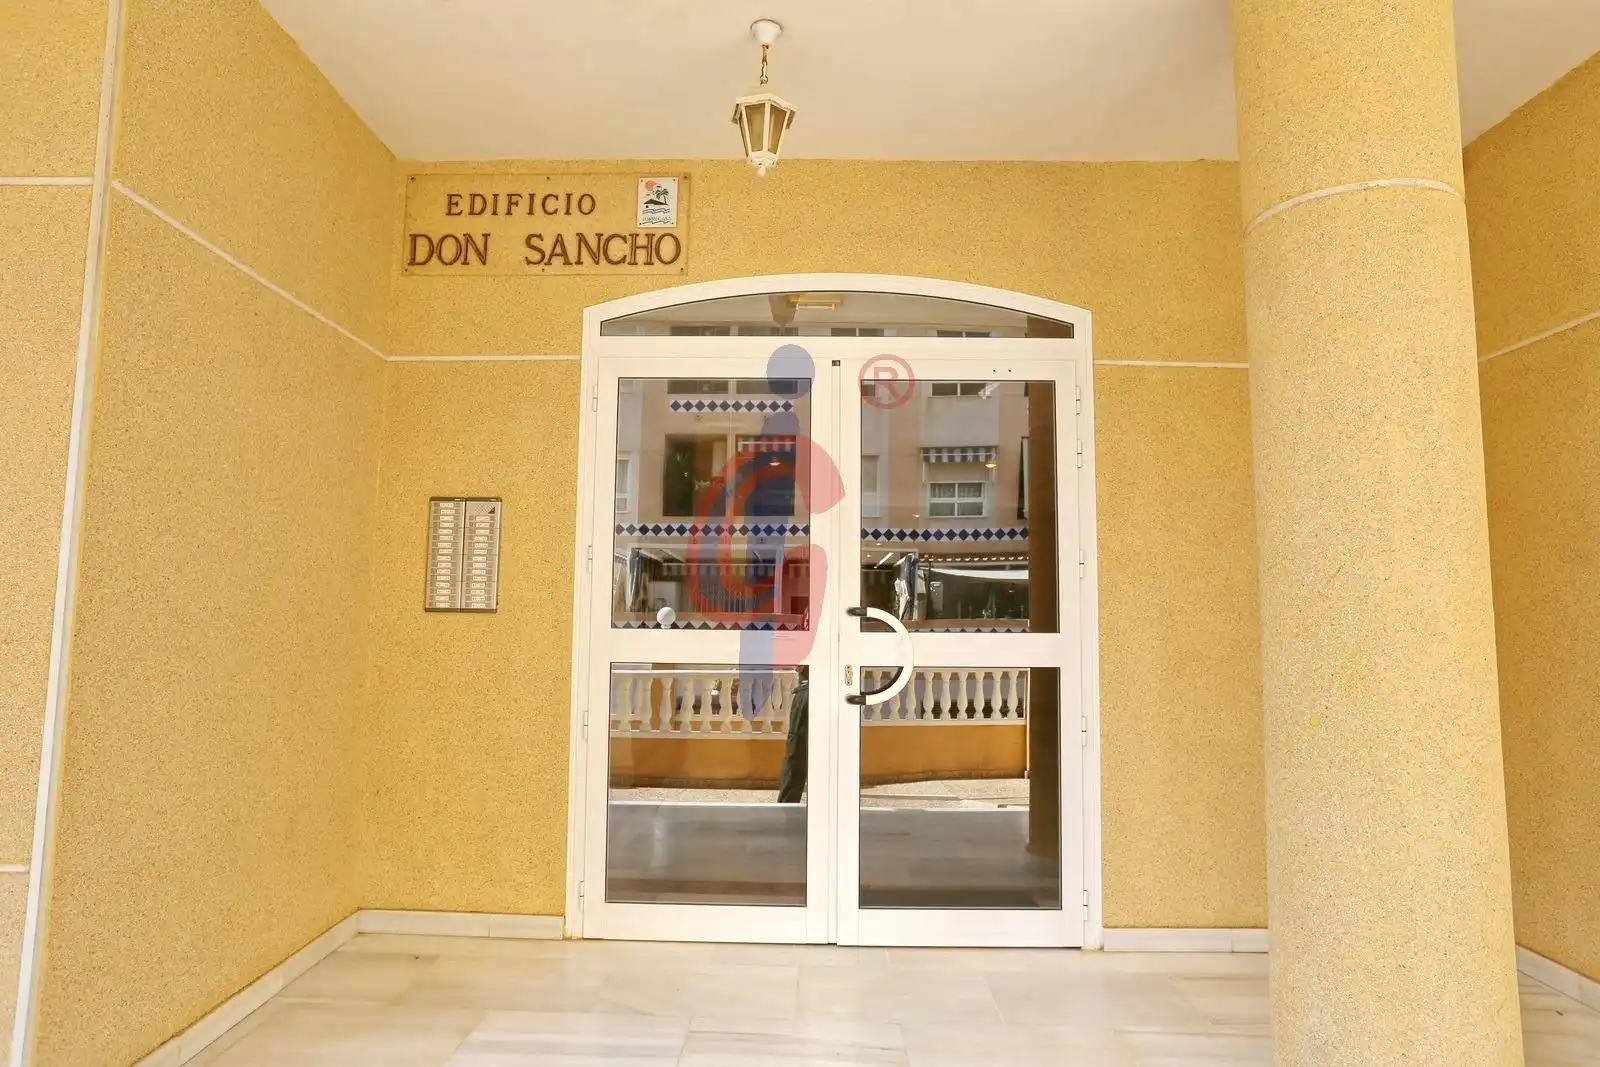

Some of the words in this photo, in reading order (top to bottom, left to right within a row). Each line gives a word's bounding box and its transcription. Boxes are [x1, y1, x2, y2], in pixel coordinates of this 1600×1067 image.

[445, 193, 596, 216] EDIFICIO
[407, 233, 491, 266] DON
[524, 232, 681, 266] SANCHO
